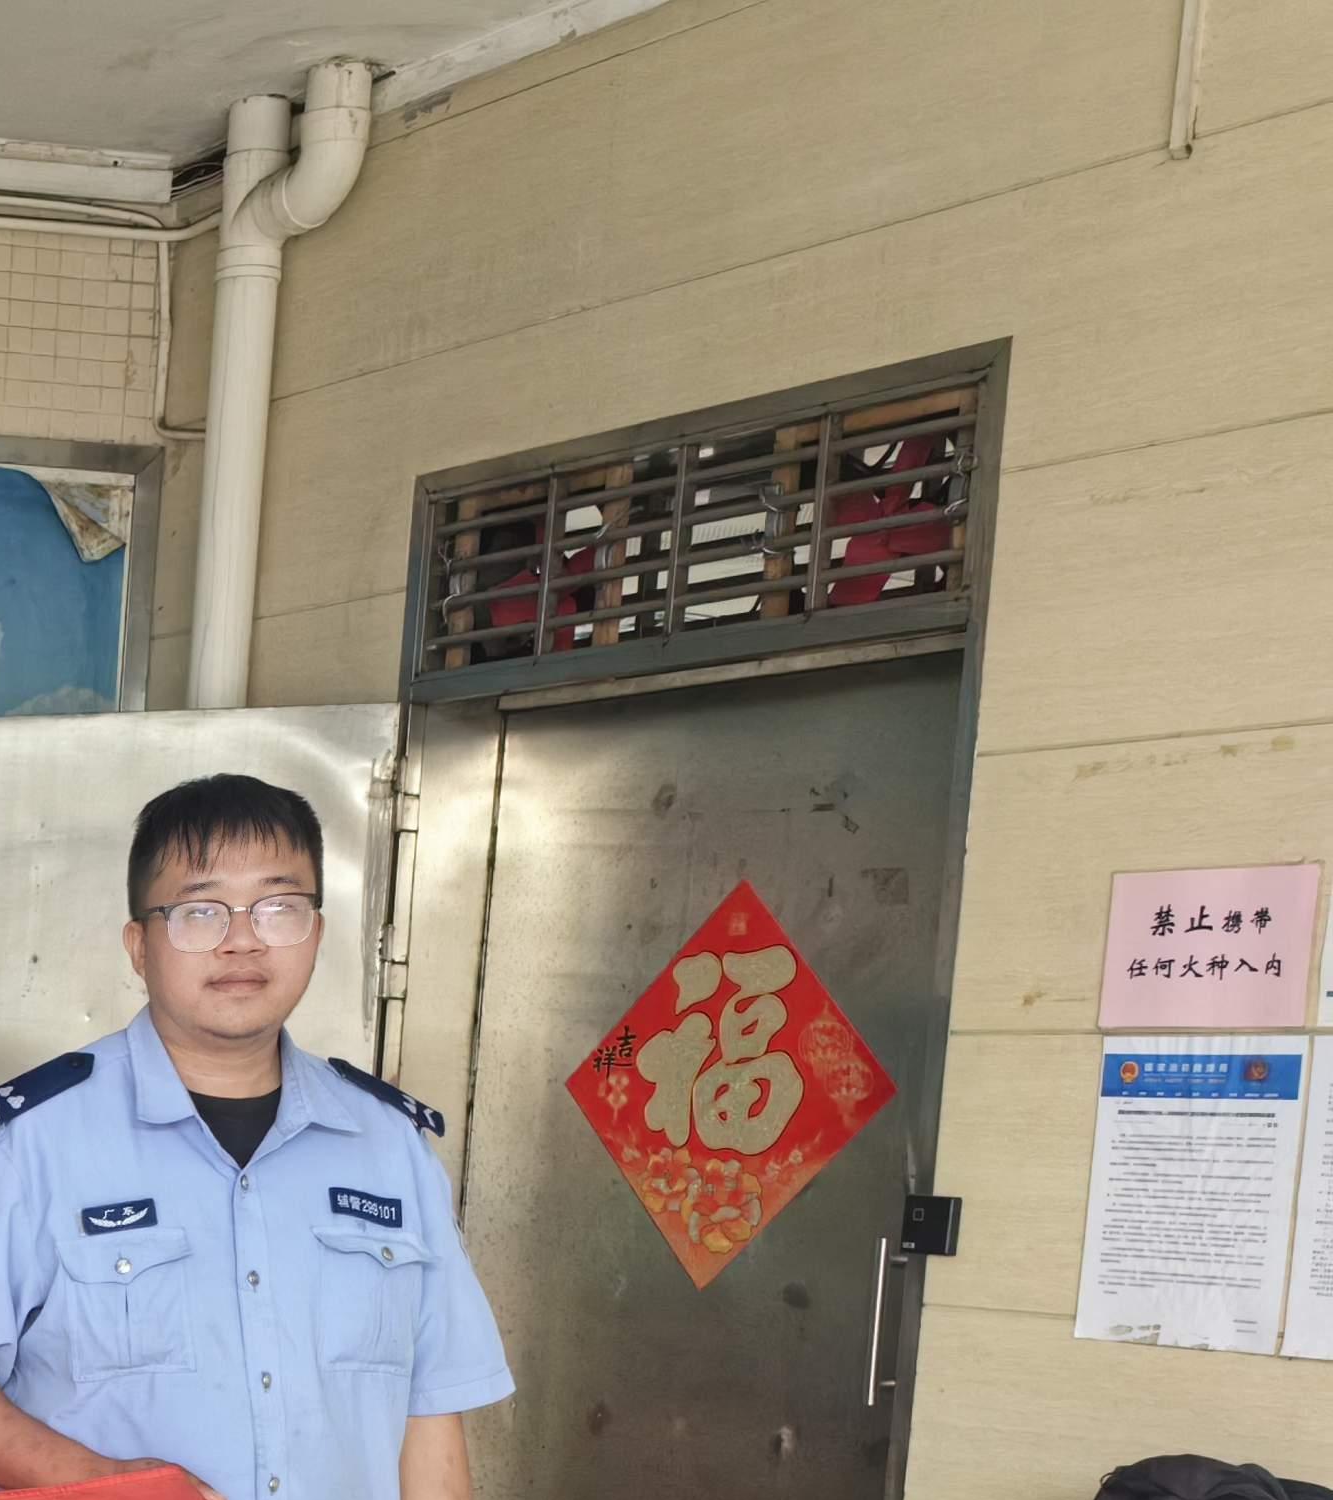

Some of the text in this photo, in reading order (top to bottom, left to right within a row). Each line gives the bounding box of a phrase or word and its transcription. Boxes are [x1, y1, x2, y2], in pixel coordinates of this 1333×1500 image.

[1126, 953, 1283, 980] 任何火种入内
[636, 944, 805, 1156] 福
